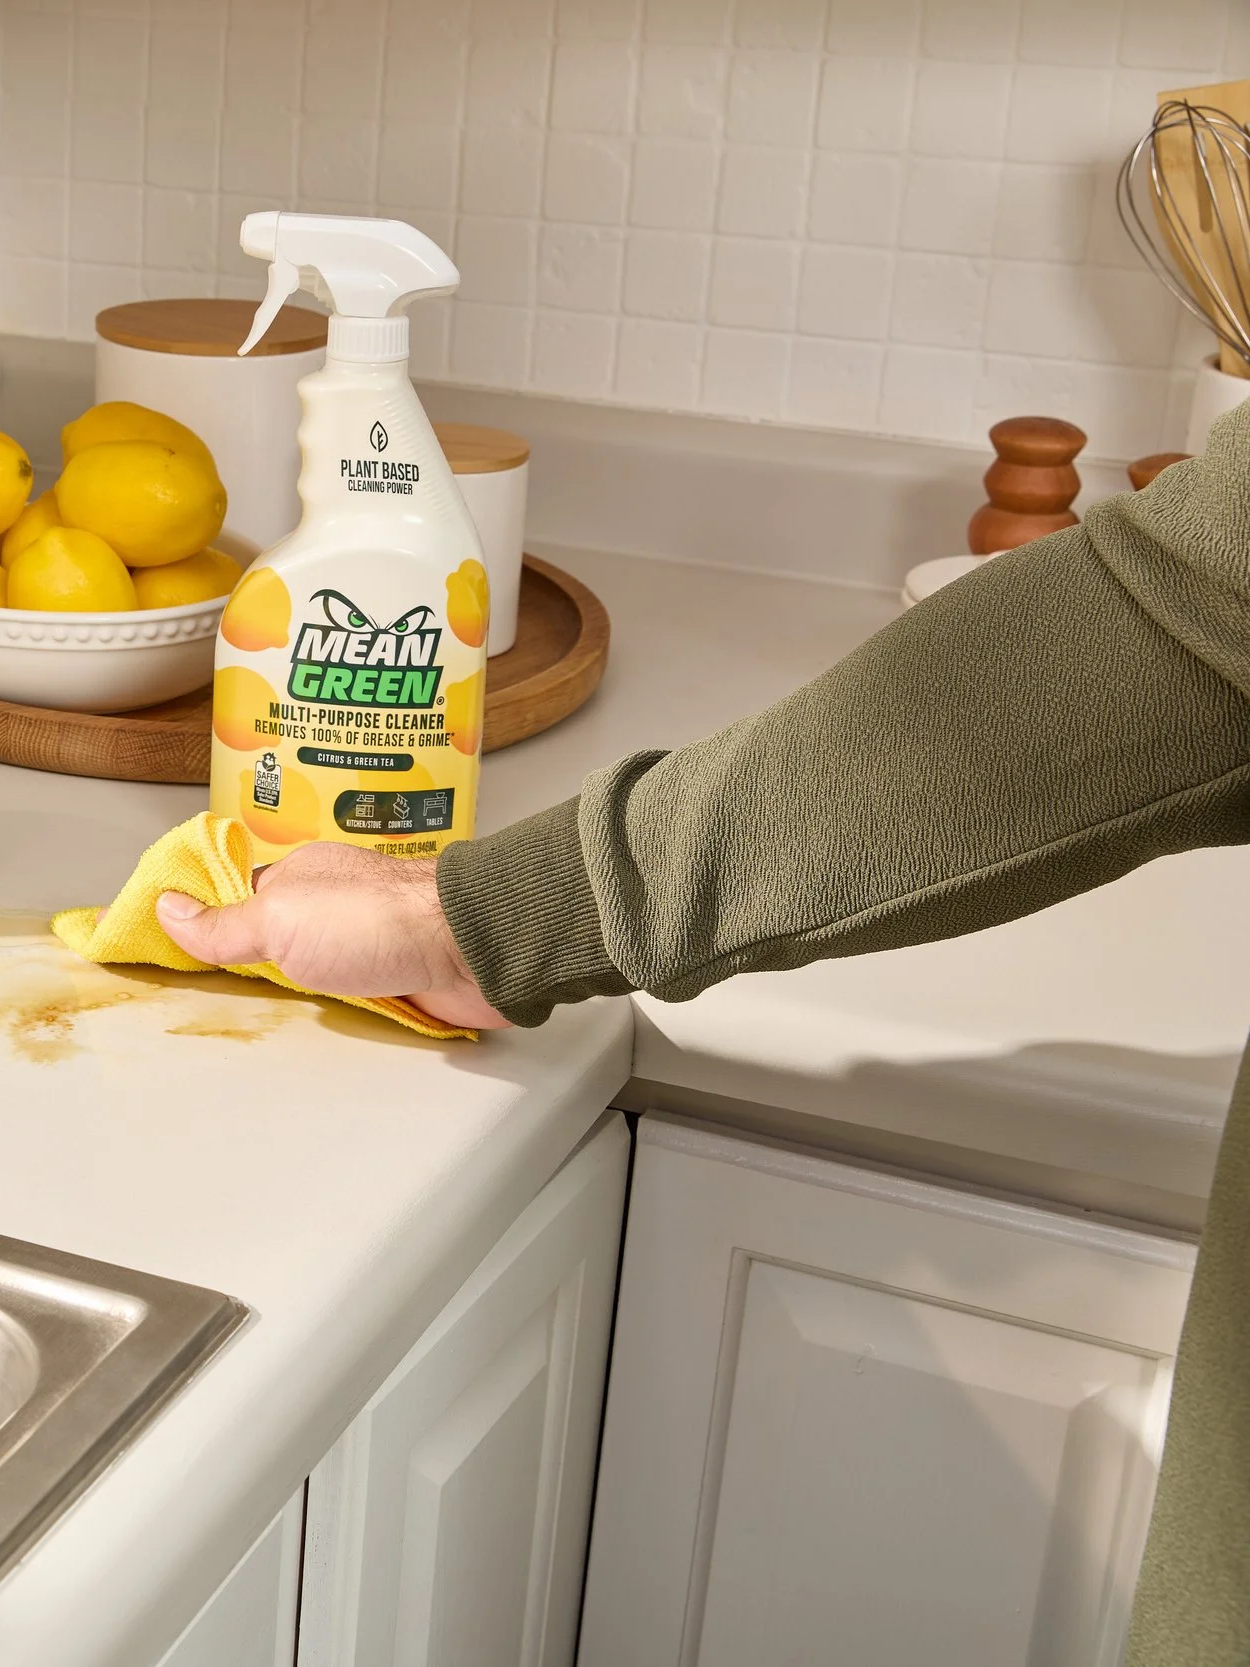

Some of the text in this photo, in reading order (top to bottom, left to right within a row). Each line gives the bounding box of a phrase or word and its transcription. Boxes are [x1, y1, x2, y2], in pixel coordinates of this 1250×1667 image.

[341, 459, 419, 482] PLANT BASED
[348, 479, 413, 495] CLEANING POWER
[296, 628, 435, 667] MEAN
[291, 664, 437, 706] GREEN
[269, 702, 444, 730] MULTI-PURPOSE CLEANER
[255, 719, 306, 740] REMOVES
[311, 728, 341, 744] 100%
[346, 731, 359, 744] OF
[363, 732, 403, 747] GREASE
[407, 734, 415, 747] &
[317, 752, 394, 767] CITRUS & GREEN TEA
[256, 770, 279, 782] SAFER
[256, 779, 278, 789] CHOICE
[346, 819, 382, 829] KITCHEN/STOVE
[388, 819, 413, 829] COUNTERS
[426, 817, 443, 826] TABLES
